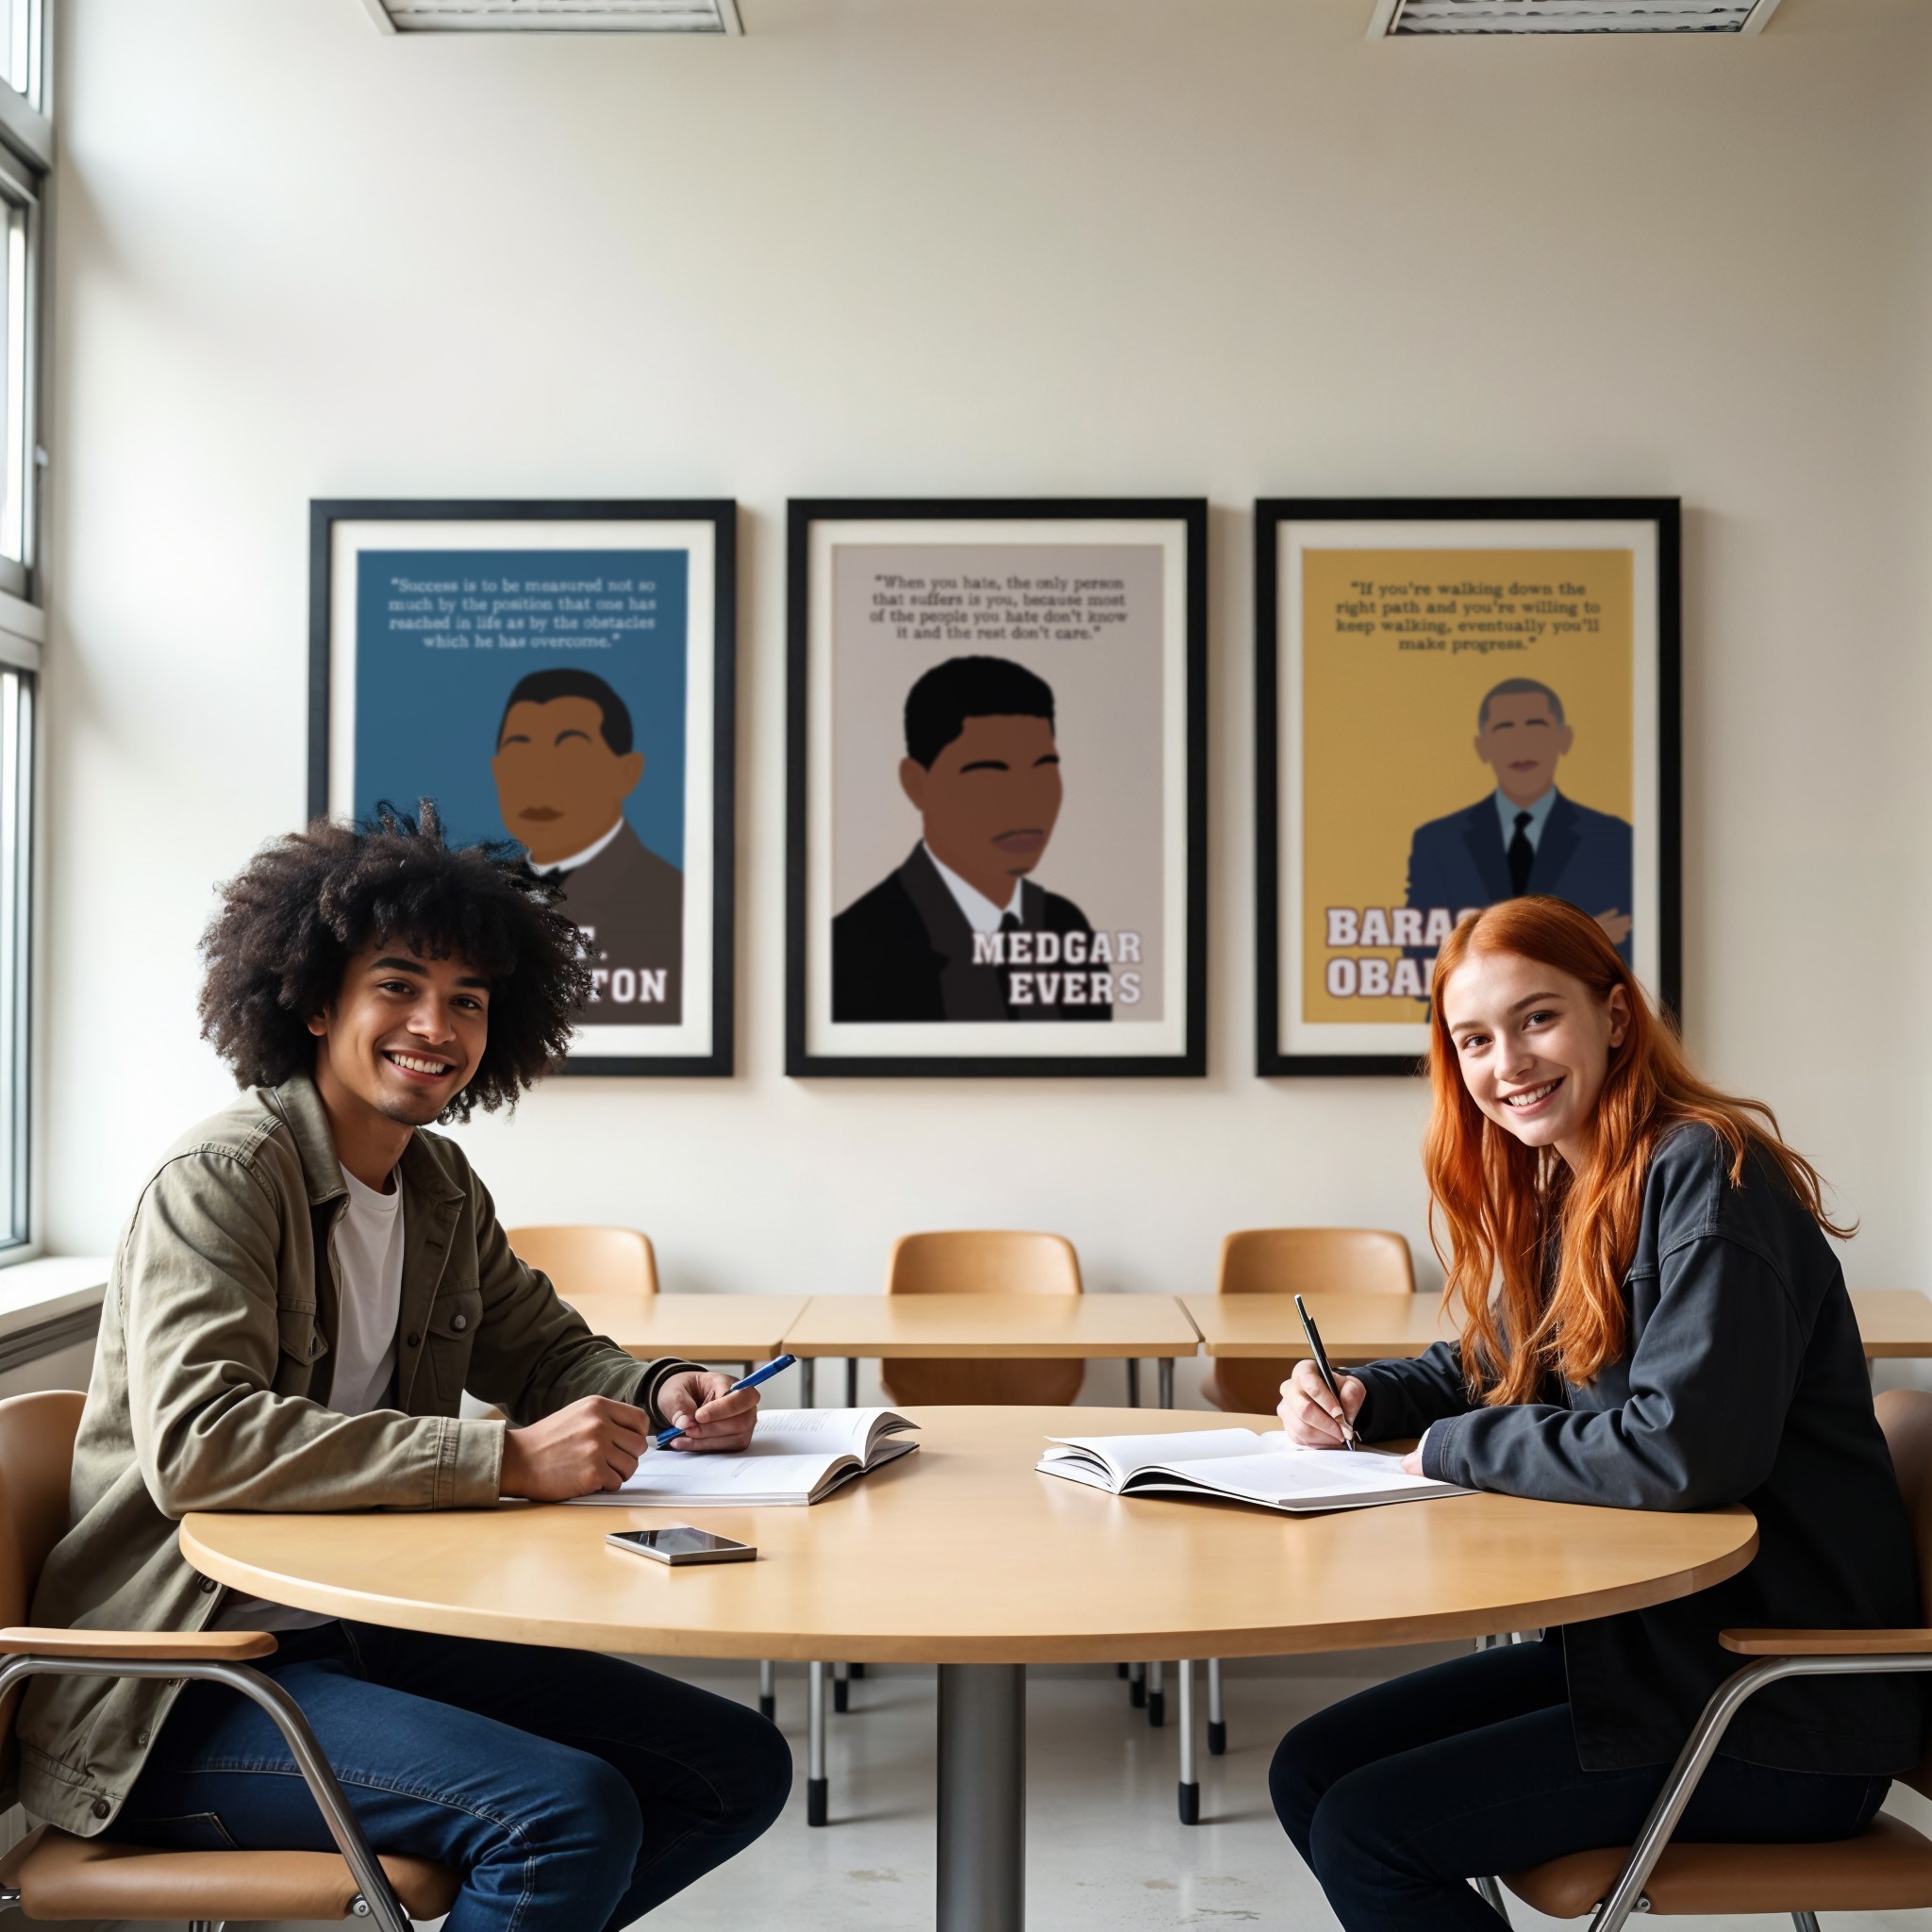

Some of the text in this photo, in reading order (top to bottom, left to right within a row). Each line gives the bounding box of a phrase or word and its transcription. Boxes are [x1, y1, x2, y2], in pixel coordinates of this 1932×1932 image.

[463, 577, 477, 592] is
[481, 577, 498, 592] to
[502, 577, 520, 592] be
[525, 577, 603, 592] measured
[608, 577, 633, 592] not
[638, 581, 657, 592] so
[929, 578, 958, 593] you
[962, 575, 1002, 591] hate,
[1006, 575, 1032, 589] the
[1035, 575, 1069, 593] only
[1074, 578, 1124, 593] person
[1378, 581, 1432, 598] you're
[1437, 581, 1504, 598] walking
[1507, 581, 1553, 595] down
[1558, 581, 1586, 595] the
[388, 596, 657, 615] much by the position that one has
[873, 592, 1125, 608] that suffers is you, because most
[1336, 600, 1601, 617] right path and you're willing to
[389, 615, 656, 633] reached in life as by the obstacles
[870, 608, 1127, 625] of the people you hate don't know
[896, 626, 908, 640] it
[913, 626, 941, 640] and
[945, 626, 972, 640] the
[976, 626, 1007, 640] rest
[1010, 626, 1050, 640] don't
[1336, 619, 1600, 636] keep walking, eventually you'll
[423, 634, 470, 648] which
[475, 634, 493, 648] he
[498, 634, 526, 648] has
[1399, 637, 1446, 650] make
[972, 930, 1142, 965] MEDGAR
[1008, 971, 1142, 1006] EVERS
